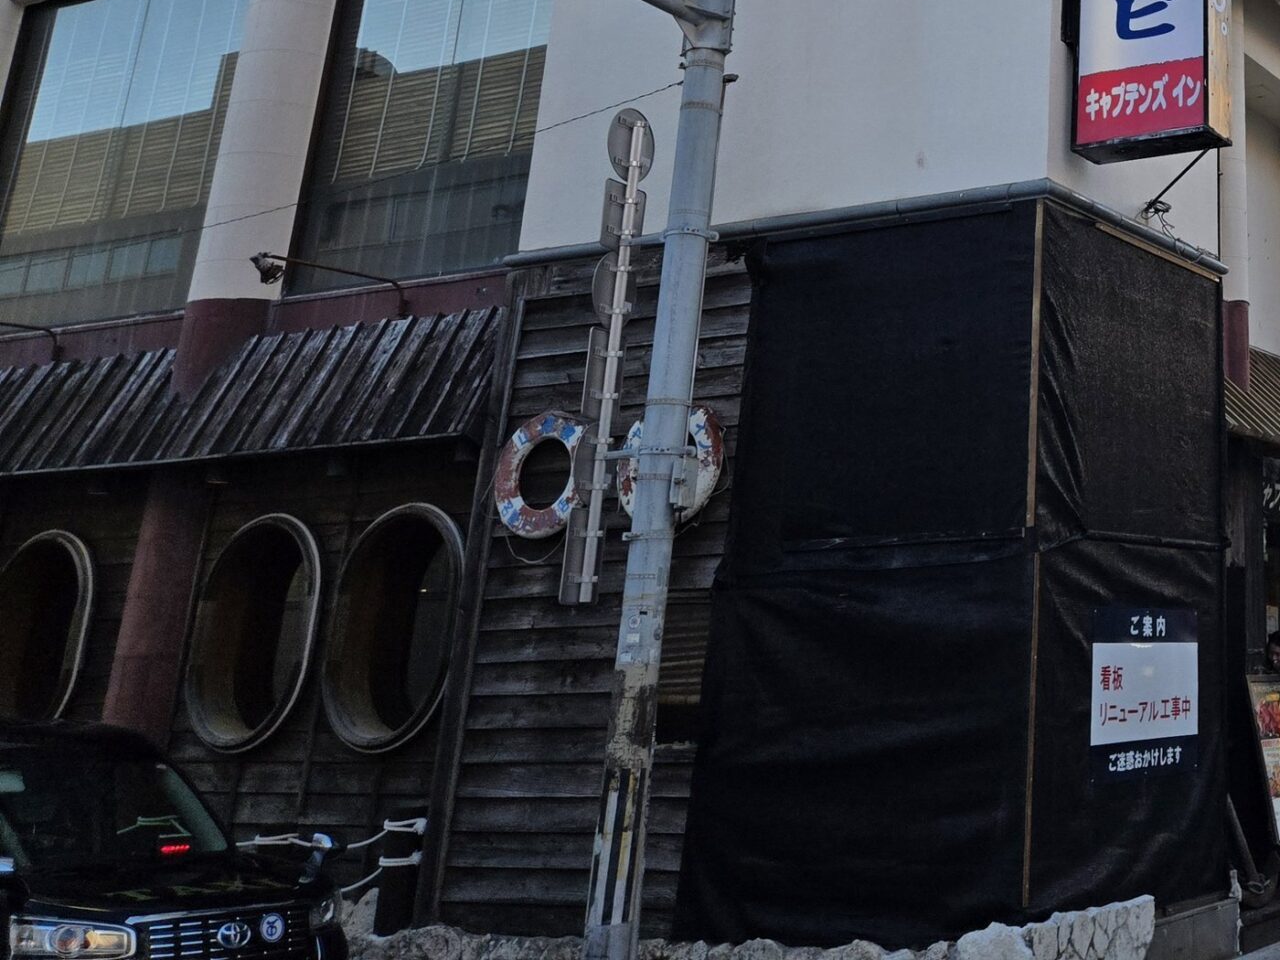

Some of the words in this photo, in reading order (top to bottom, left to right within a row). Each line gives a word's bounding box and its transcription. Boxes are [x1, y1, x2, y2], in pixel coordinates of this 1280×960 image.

[1085, 74, 1169, 121] キャプテンズ
[1172, 76, 1201, 107] イン
[1130, 615, 1166, 637] ご案内
[1100, 665, 1124, 690] 看板
[1099, 696, 1191, 726] リニューアル工事中
[1109, 746, 1182, 772] ご迷惑おかけします
